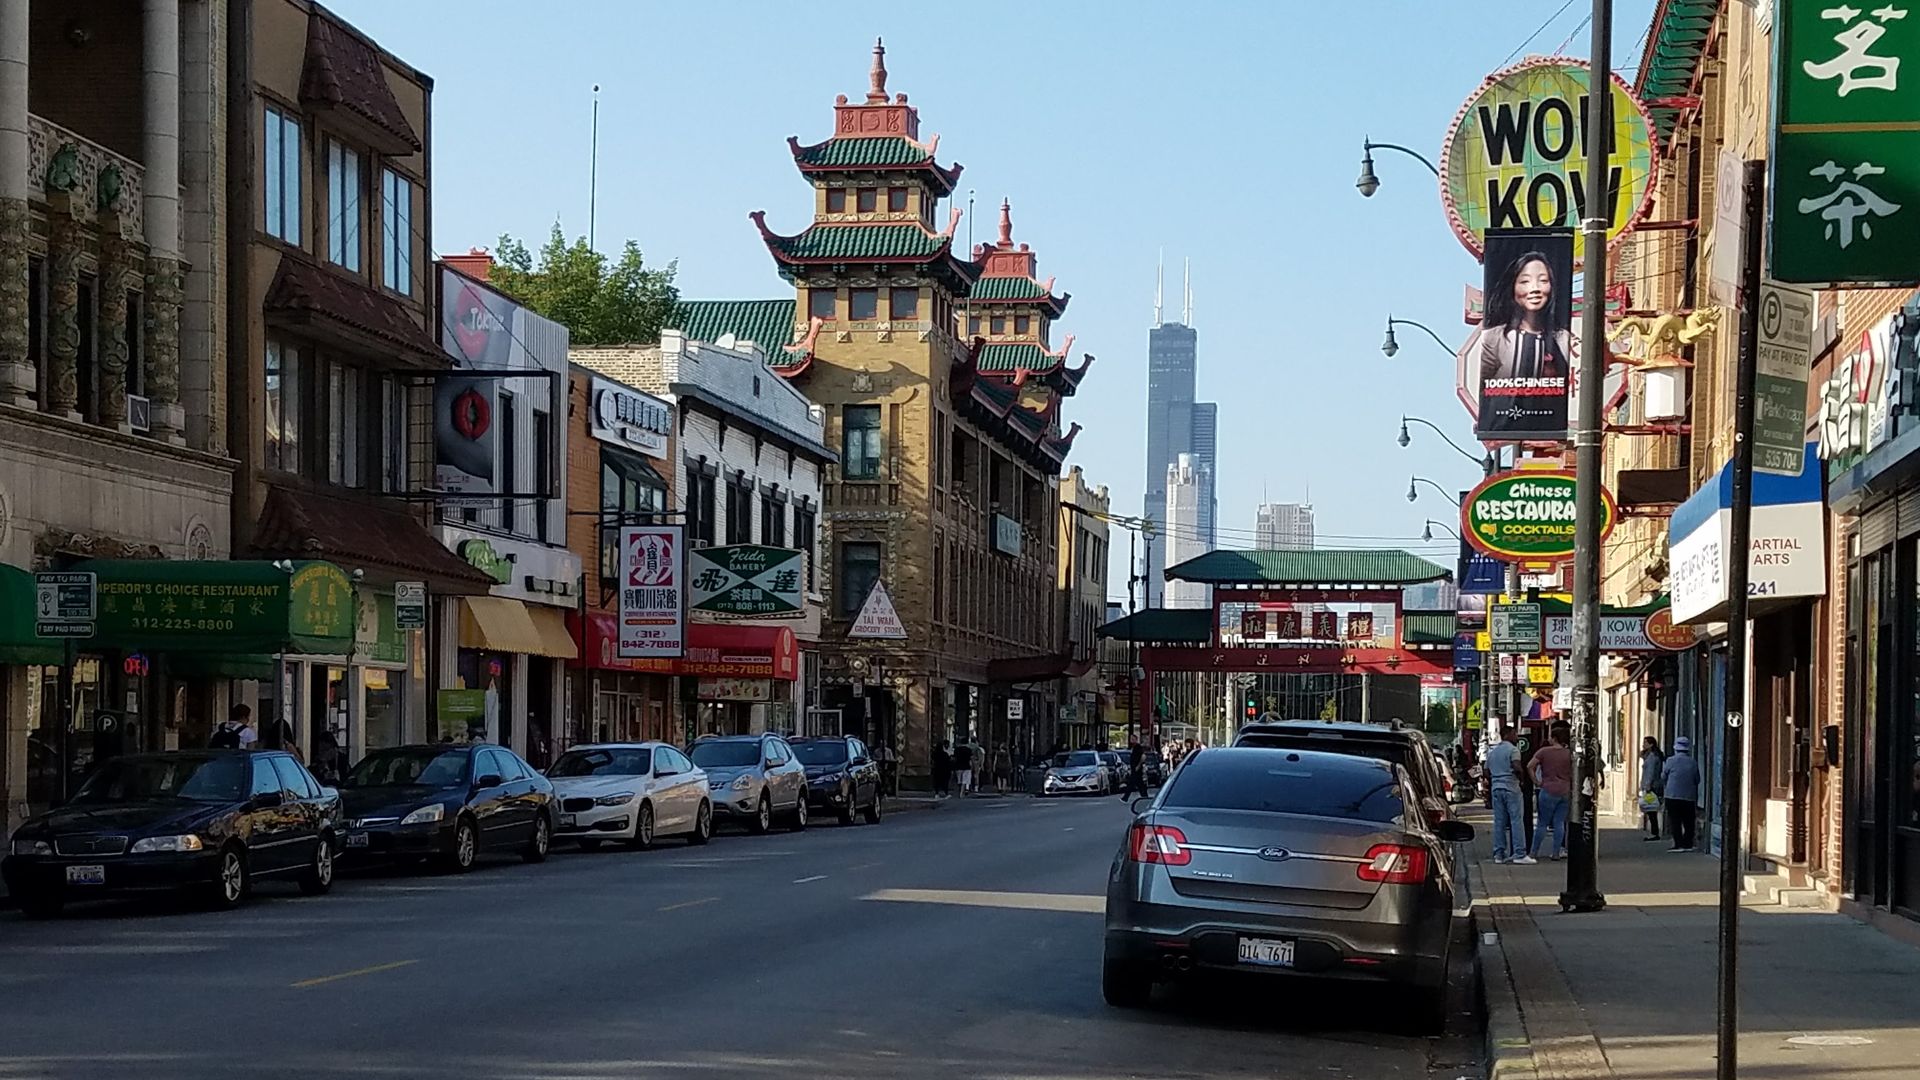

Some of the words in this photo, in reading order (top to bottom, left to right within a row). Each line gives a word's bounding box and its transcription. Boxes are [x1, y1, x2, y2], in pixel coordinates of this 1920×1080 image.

[1793, 354, 1807, 367] BOX
[1782, 452, 1797, 470] 704
[1509, 482, 1572, 499] Chinese
[1475, 499, 1577, 522] RESTAURA
[1502, 524, 1577, 535] COCKTAILS
[1749, 538, 1802, 550] ARTIAL
[1754, 553, 1790, 565] ARTS
[729, 563, 767, 571] BAKERY
[39, 575, 55, 583] PAY
[57, 575, 68, 583] TO
[69, 575, 88, 583] PARK
[96, 582, 152, 595] MPEROR'S
[155, 583, 199, 596] CHOICE
[203, 584, 280, 597] RESTAURANT
[131, 617, 234, 631] 312-225-8800
[1607, 620, 1637, 633] KOW
[635, 630, 666, 638] (312)
[622, 640, 680, 648] 842-7888
[680, 663, 773, 675] 312-842-7888
[1264, 847, 1284, 857] Ford
[1267, 946, 1292, 963] 7671
